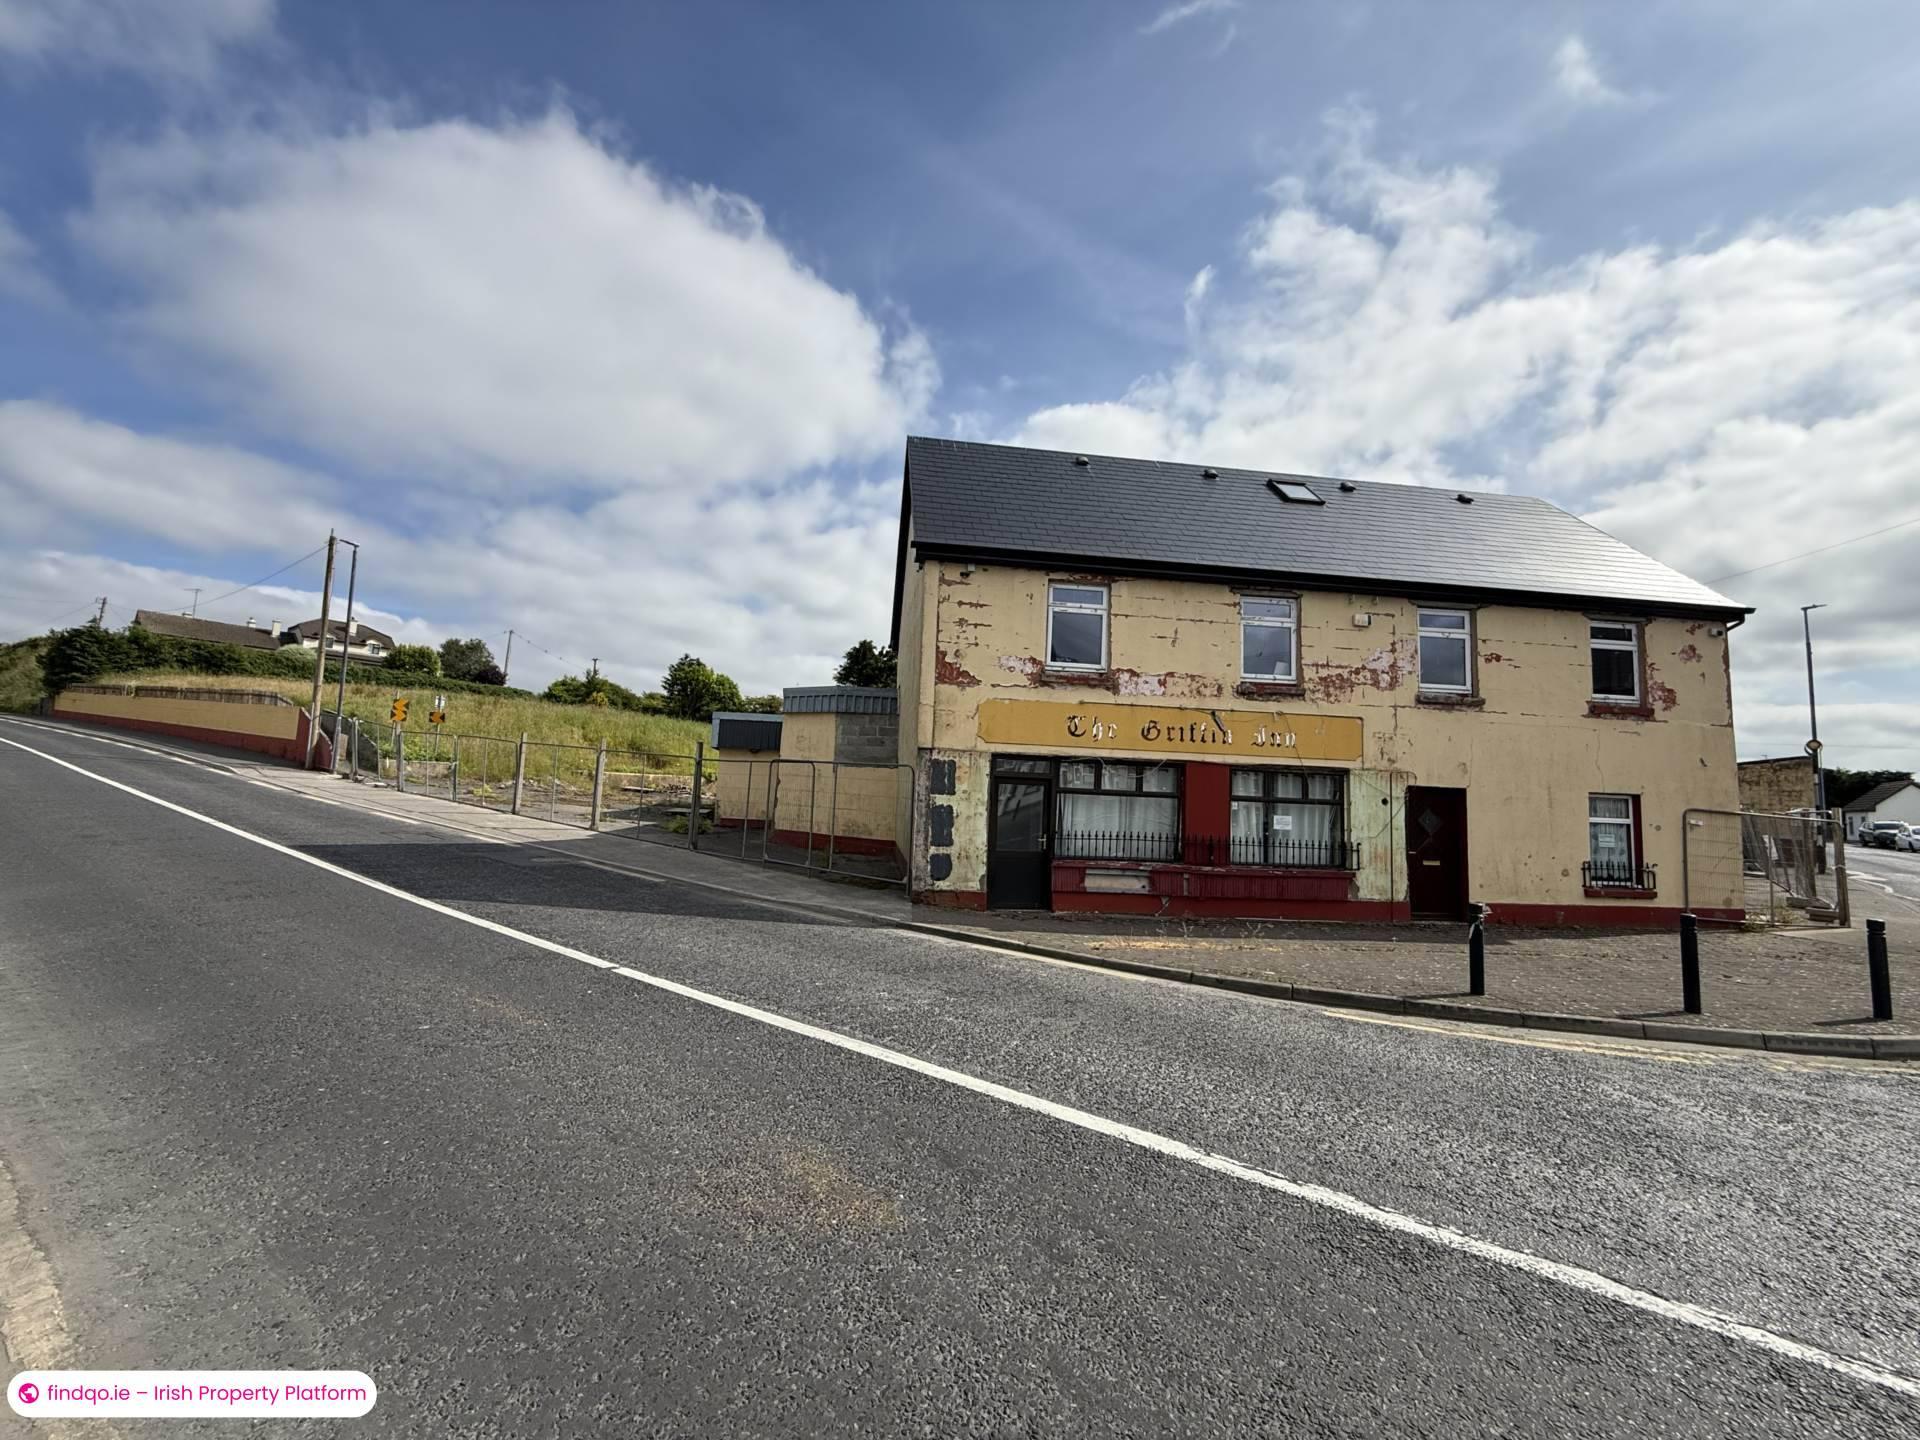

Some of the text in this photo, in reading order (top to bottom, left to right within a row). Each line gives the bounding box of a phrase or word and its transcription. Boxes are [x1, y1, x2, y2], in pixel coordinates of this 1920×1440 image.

[1067, 714, 1297, 748] The Griffin Inn
